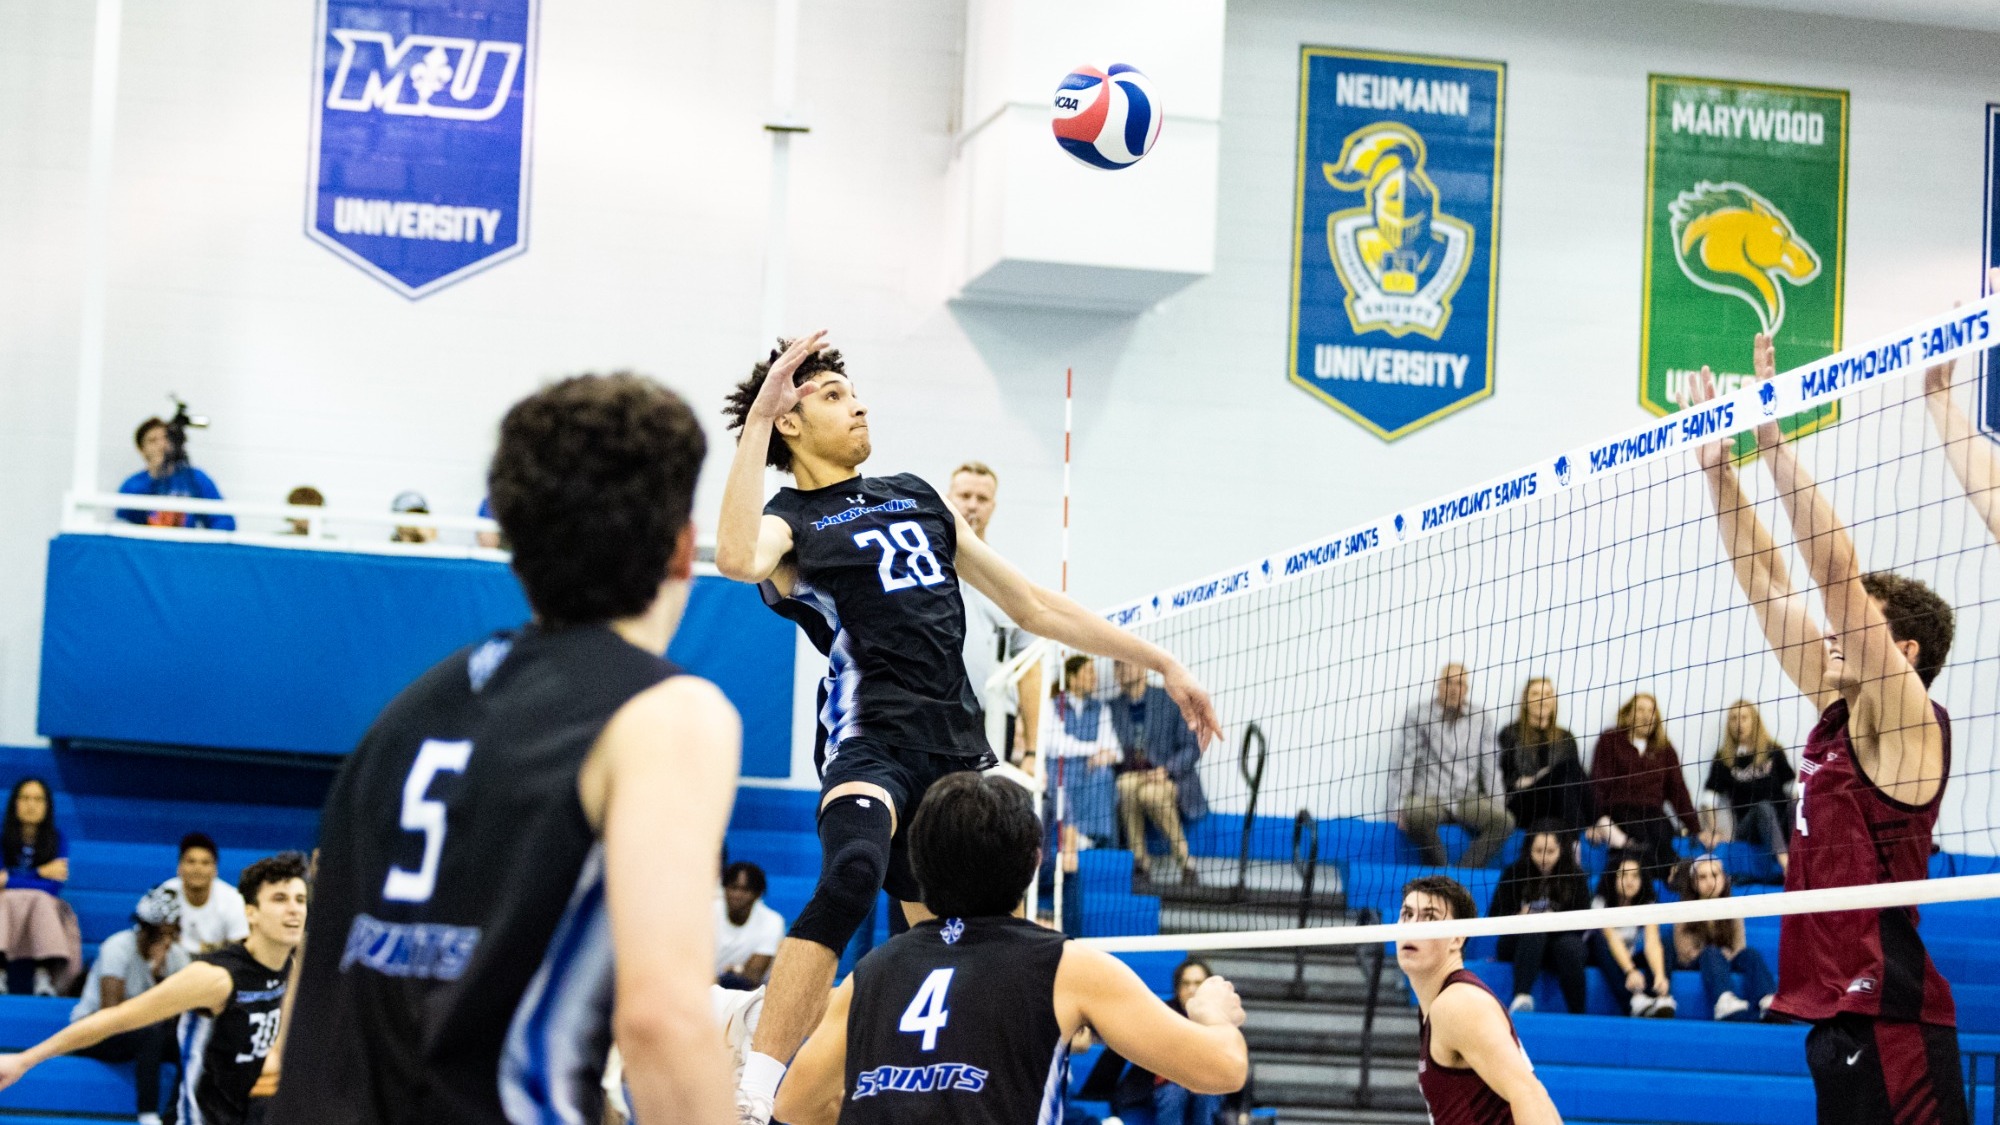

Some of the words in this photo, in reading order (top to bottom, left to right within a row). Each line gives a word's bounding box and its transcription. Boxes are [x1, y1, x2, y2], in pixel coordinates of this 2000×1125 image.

[1336, 72, 1469, 116] NEUMANN
[1672, 100, 1825, 145] MARYWOOD
[334, 196, 501, 244] UNIVERSITY
[1314, 344, 1469, 389] UNIVERSITY
[1801, 337, 1913, 400] MARYMOUNT
[1920, 310, 1989, 360] SAINTS
[1590, 421, 1677, 474] MARYMOUNT
[1682, 402, 1734, 442] SAINTS
[1495, 472, 1537, 507] SAINTS
[854, 521, 945, 592] 28
[383, 738, 474, 903] 5
[899, 968, 954, 1050] 4
[235, 1008, 281, 1063] 30
[852, 1062, 989, 1100] SAINTS
